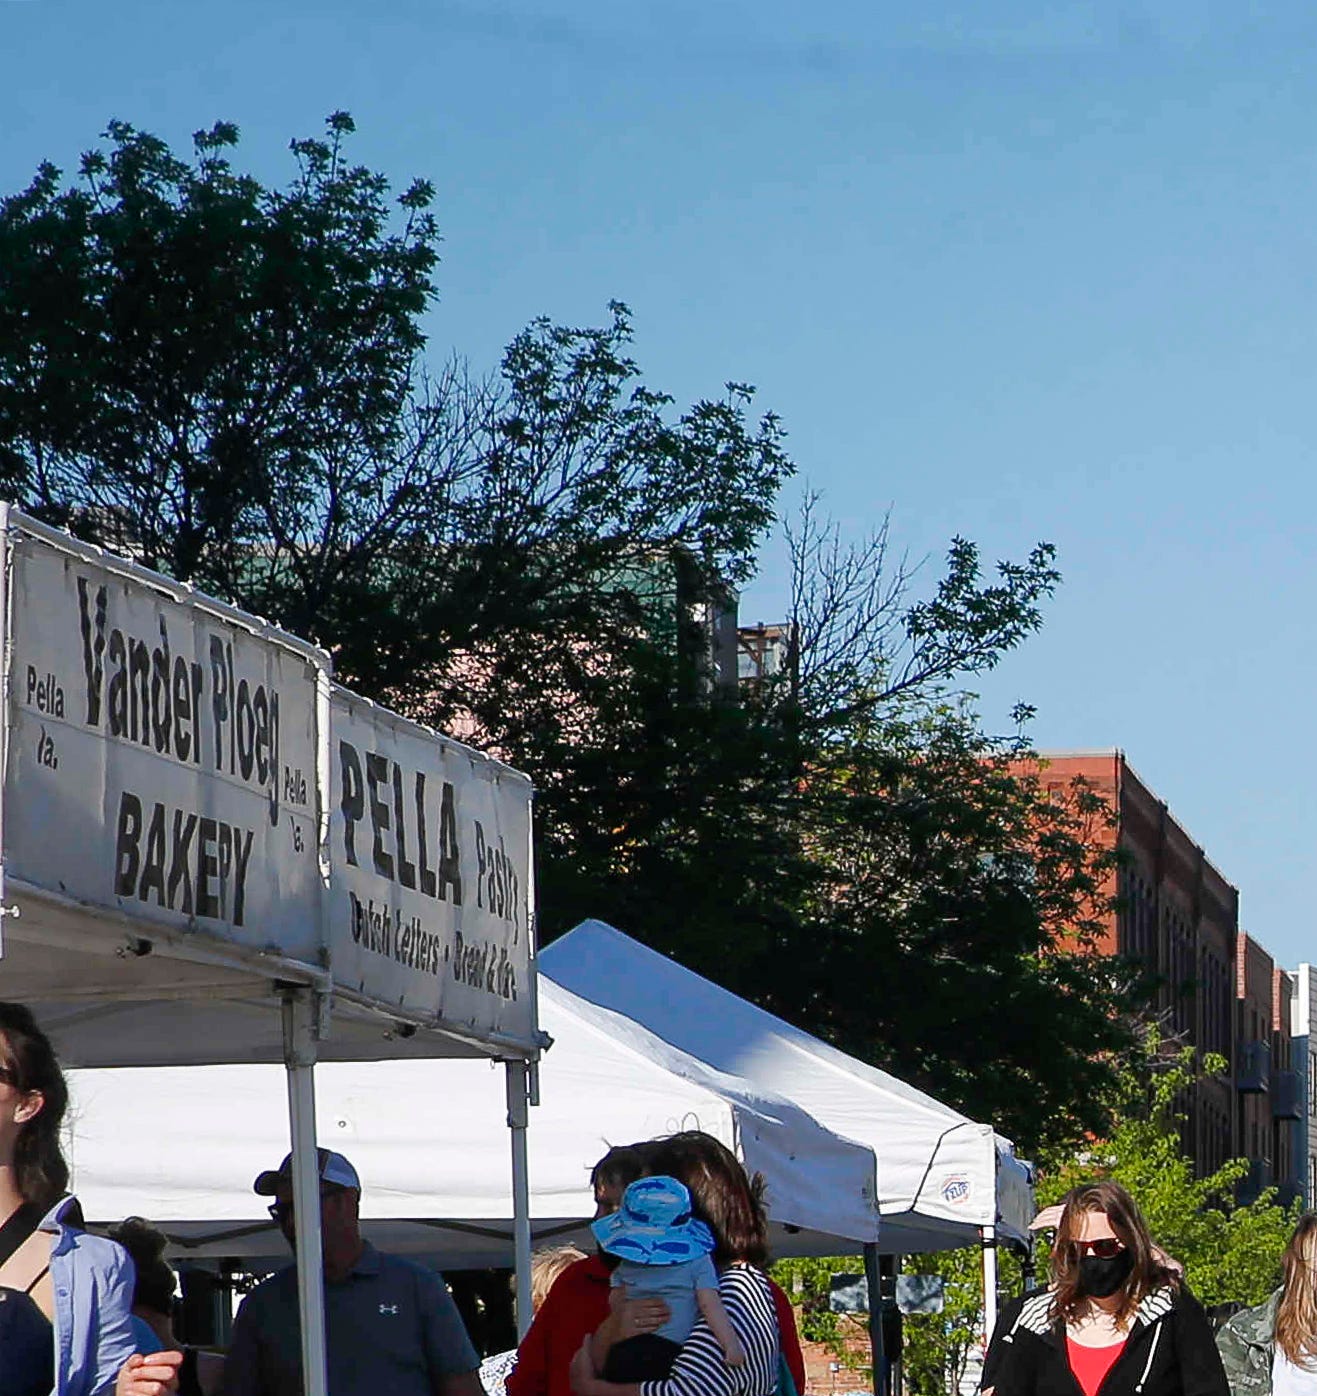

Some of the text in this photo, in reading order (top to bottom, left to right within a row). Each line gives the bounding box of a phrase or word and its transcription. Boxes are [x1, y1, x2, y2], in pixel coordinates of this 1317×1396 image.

[27, 665, 64, 718] Pella
[77, 576, 278, 827] Vander Ploeg
[284, 766, 306, 805] Pella
[339, 739, 462, 907] PELLA
[114, 791, 255, 927] BAKERY
[395, 908, 440, 975] Letters
